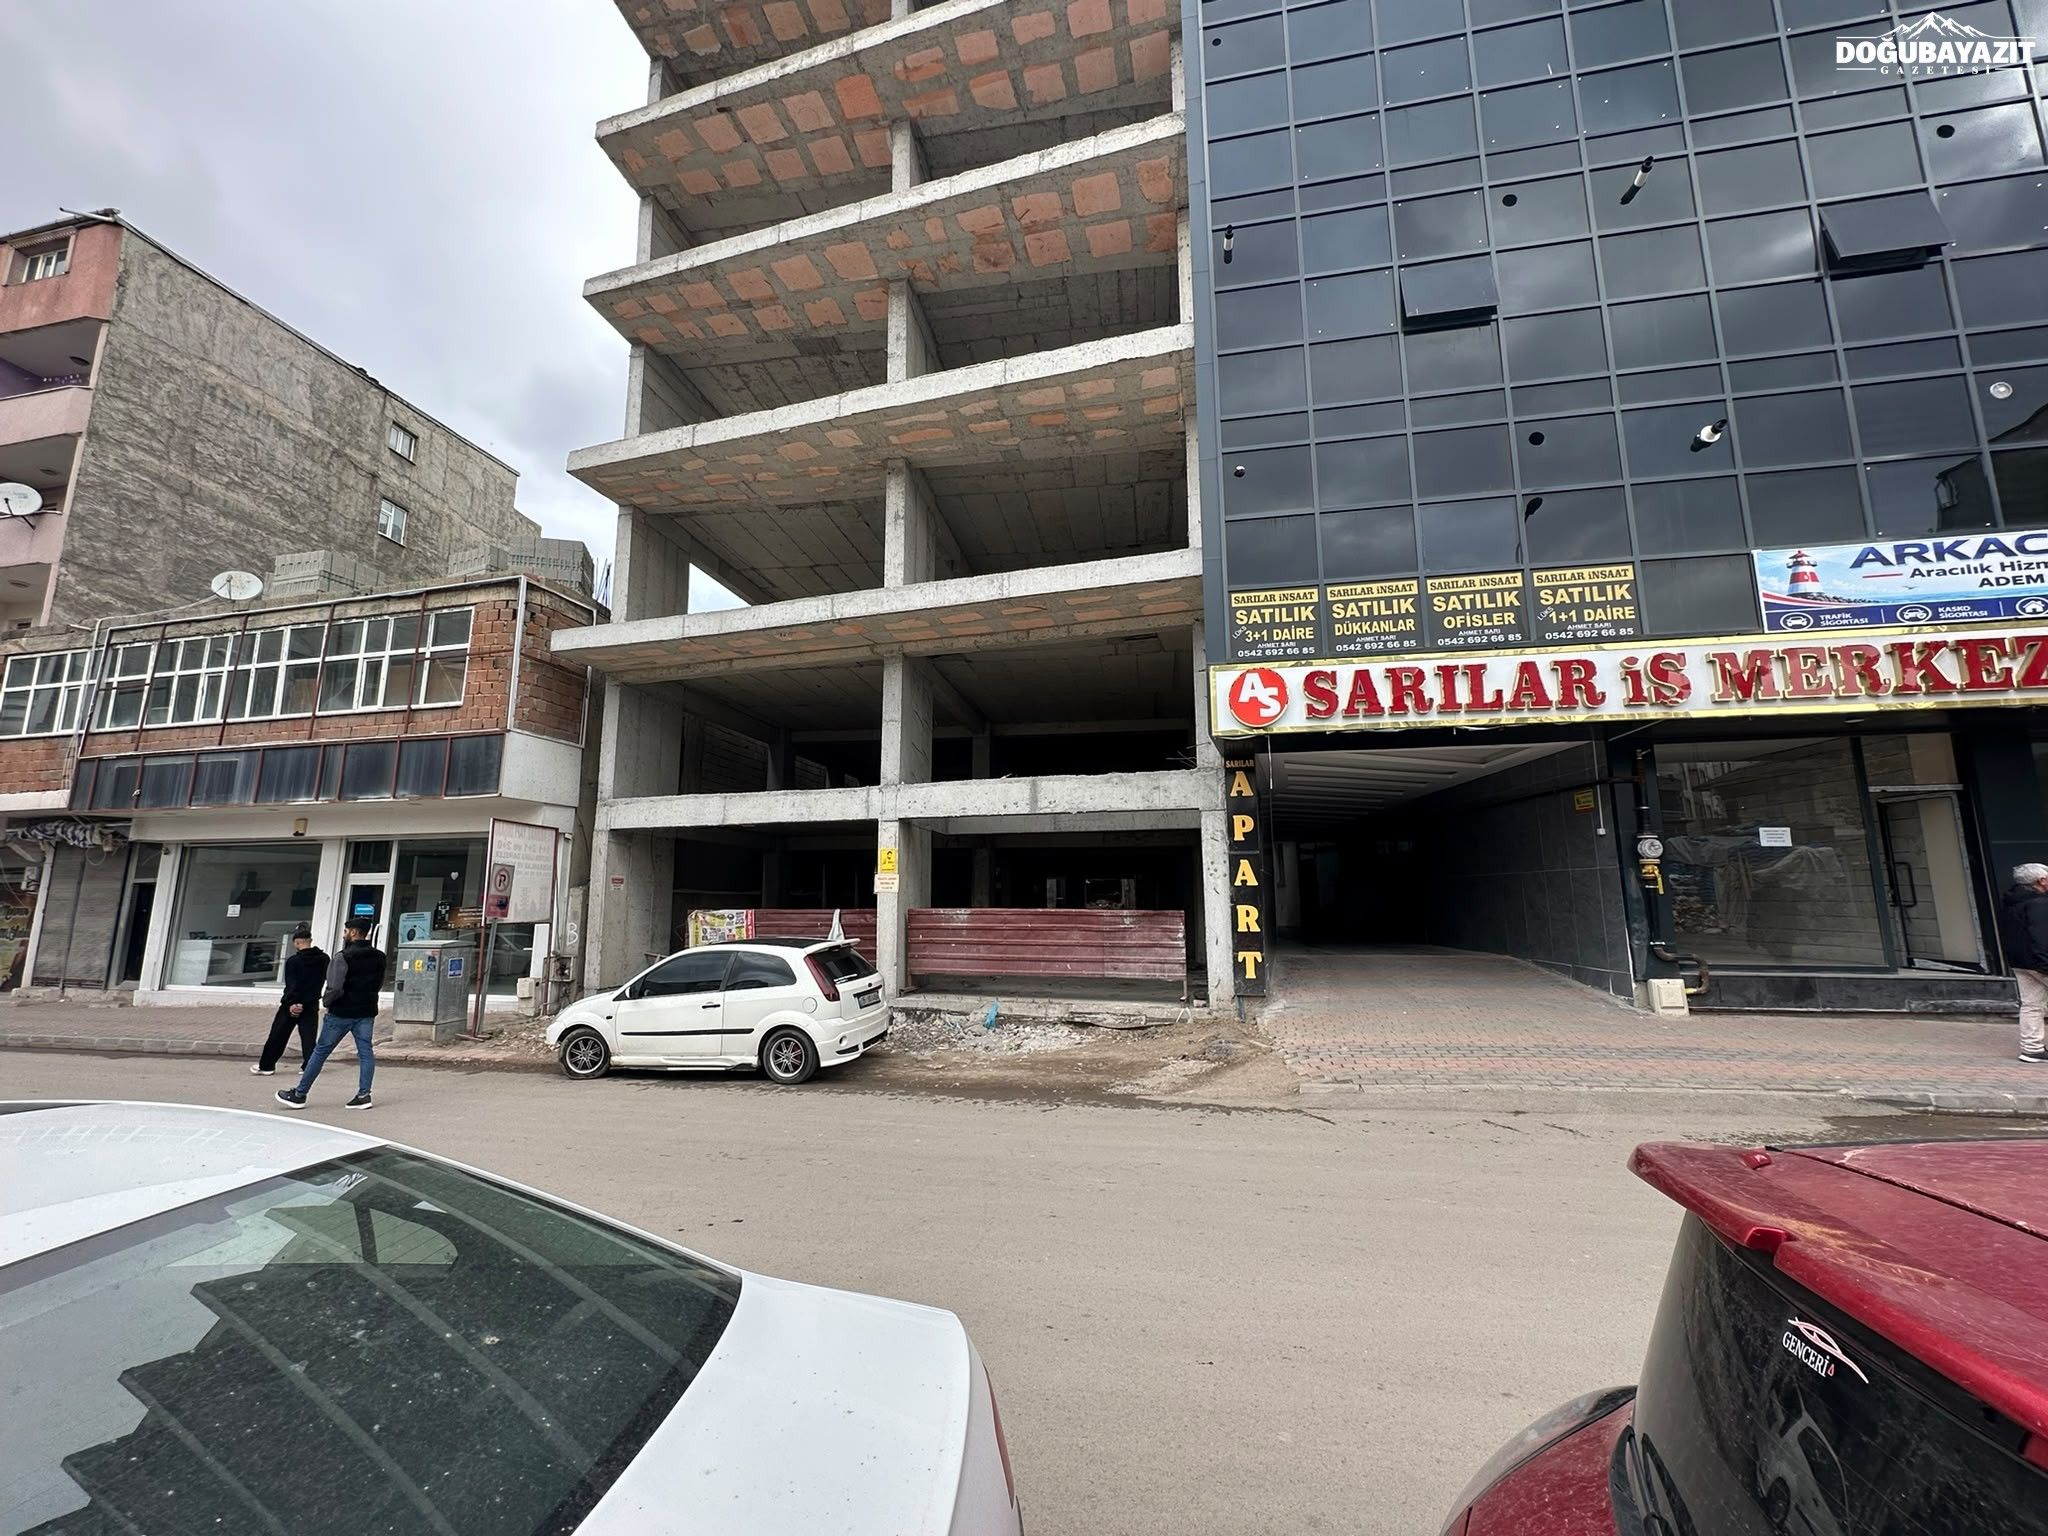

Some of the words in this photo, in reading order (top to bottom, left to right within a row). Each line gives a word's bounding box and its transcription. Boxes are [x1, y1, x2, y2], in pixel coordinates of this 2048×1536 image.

[1536, 572, 1585, 583] SARILAR
[1910, 562, 1992, 578] Aracılık
[1430, 579, 1476, 591] SARILAR
[1979, 573, 2045, 588] ADEM
[1233, 594, 1276, 604] SARILAR
[1330, 587, 1374, 598] SARILAR
[1540, 584, 1632, 605] SATILIK
[1332, 598, 1415, 618] SATILIK
[1433, 591, 1520, 612] SATILIK
[1938, 605, 1971, 613] KASKO
[1236, 606, 1316, 624] SATILIK
[1444, 612, 1516, 628] OFİSLER
[1549, 610, 1577, 624] 1+1
[1584, 605, 1635, 622] DAİRE
[1820, 612, 1852, 620] TRAFİK
[1245, 629, 1268, 642] 3+1
[1273, 625, 1314, 640] DAİRE
[1335, 619, 1415, 636] DÜKKANLAR
[1545, 632, 1574, 640] 0542
[1577, 630, 1598, 638] 692
[1468, 636, 1488, 644] 692
[1238, 649, 1262, 657] 0542
[1303, 658, 1606, 720] SARILAR
[1705, 634, 2048, 703] MERKEZ
[1226, 760, 1254, 768] SARILAR
[1230, 771, 1263, 979] APART
